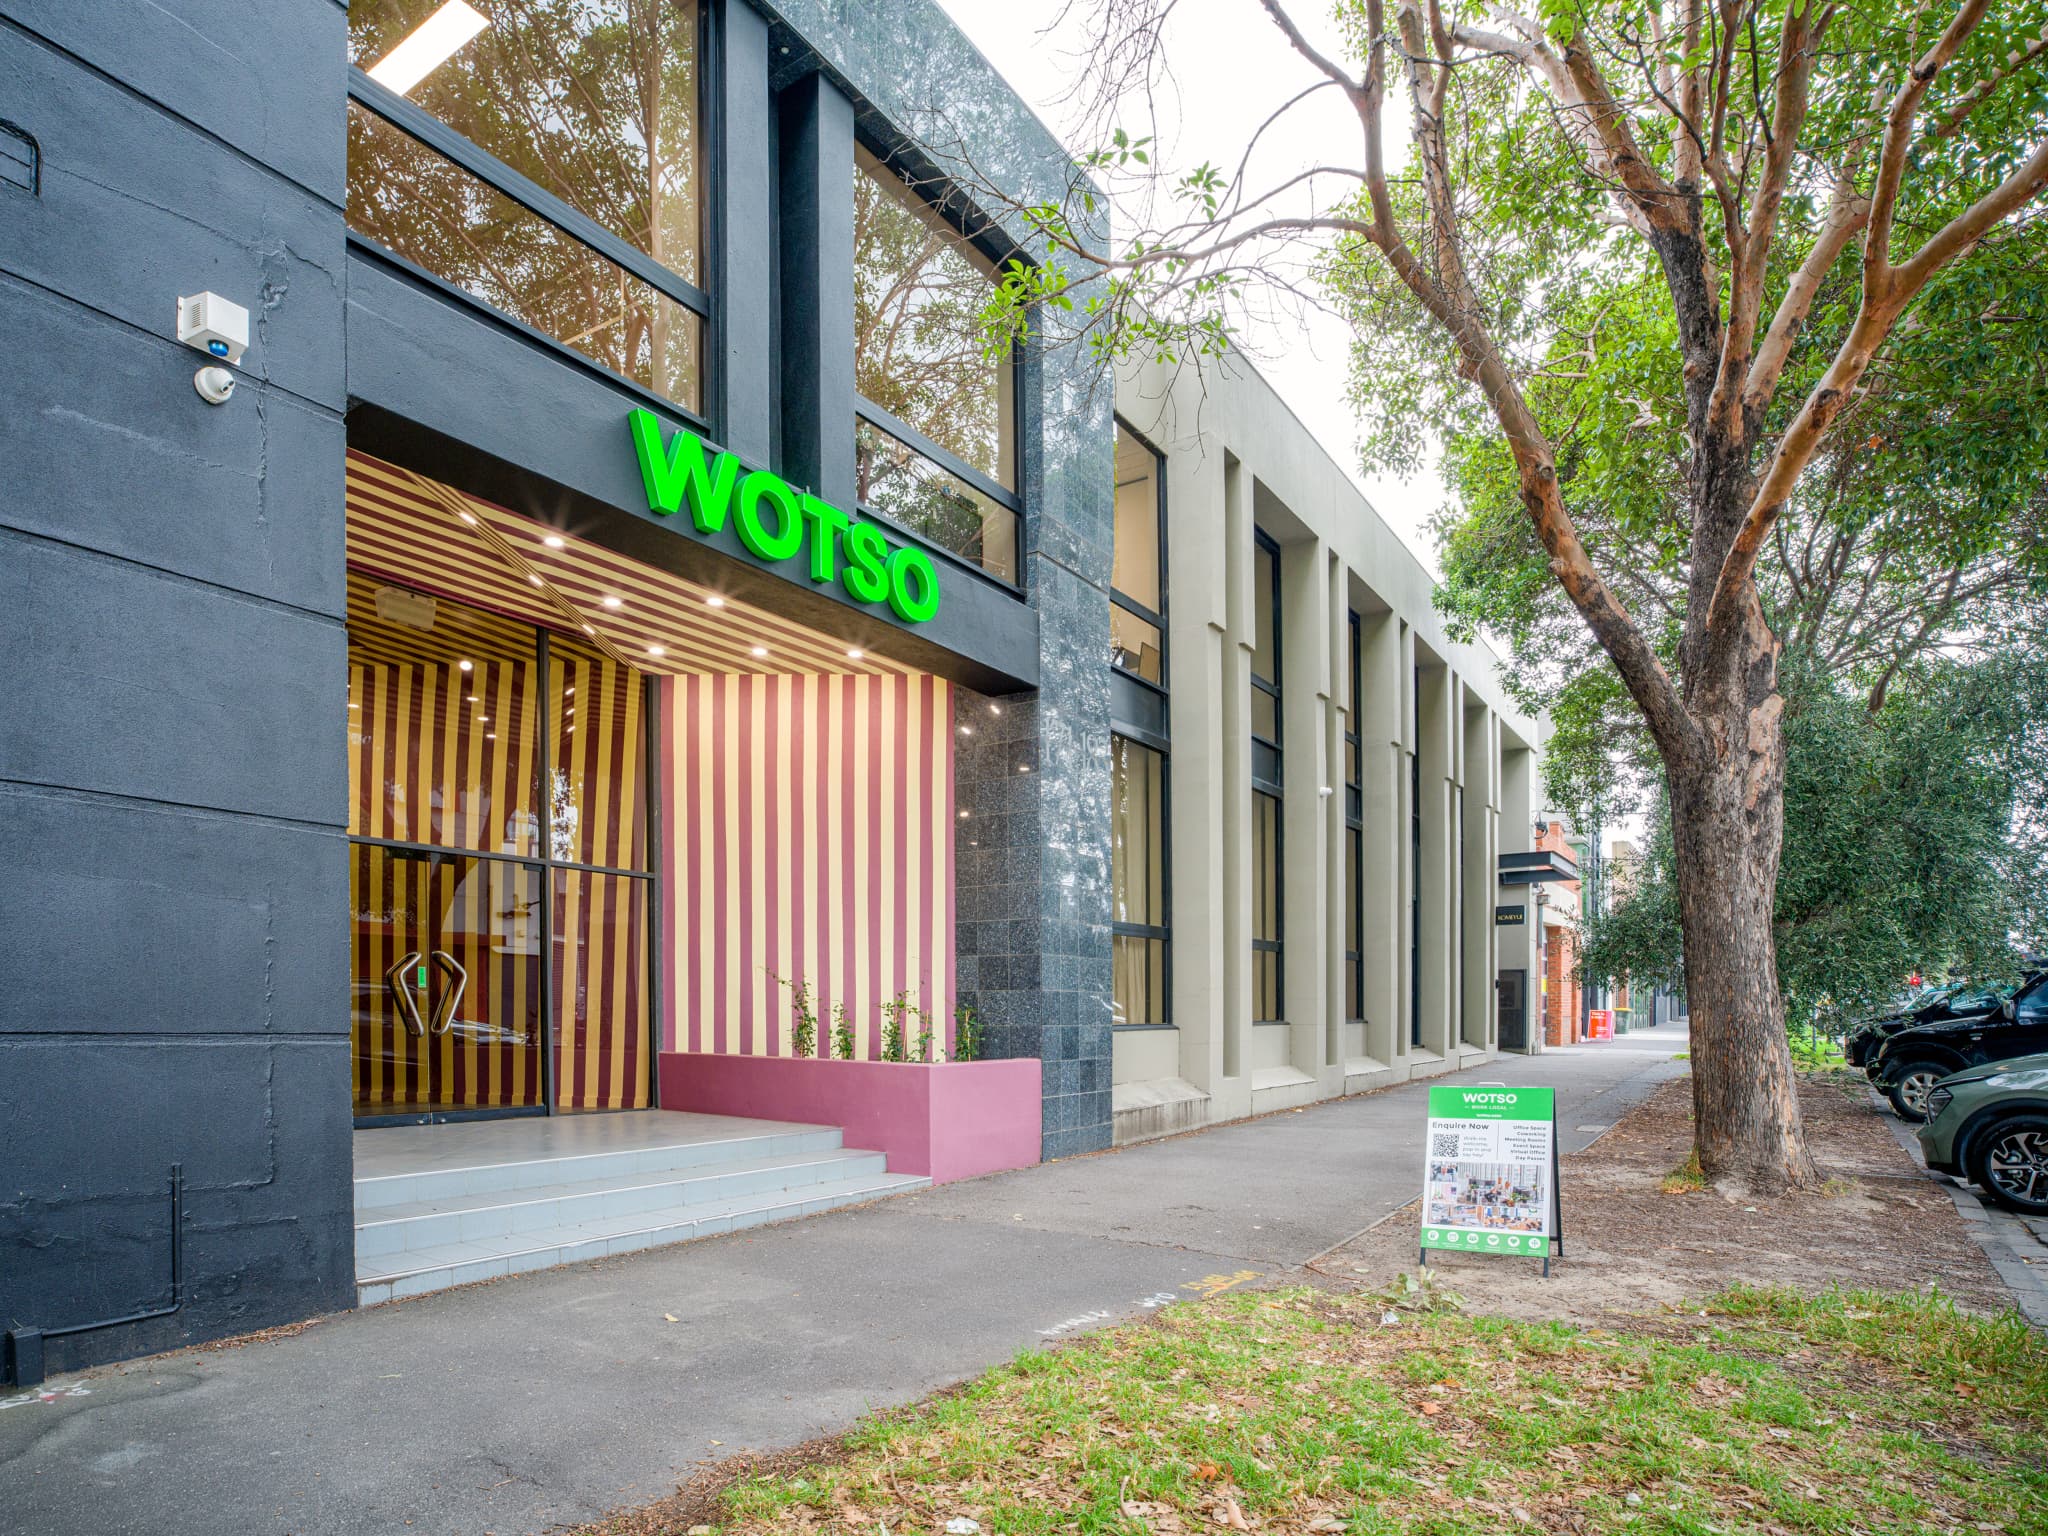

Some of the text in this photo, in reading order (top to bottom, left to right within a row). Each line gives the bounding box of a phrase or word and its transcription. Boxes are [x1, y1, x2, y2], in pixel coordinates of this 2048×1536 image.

[628, 408, 939, 623] WOTSO
[1463, 1093, 1517, 1104] WOTSO
[1432, 1121, 1467, 1130] Enquire
